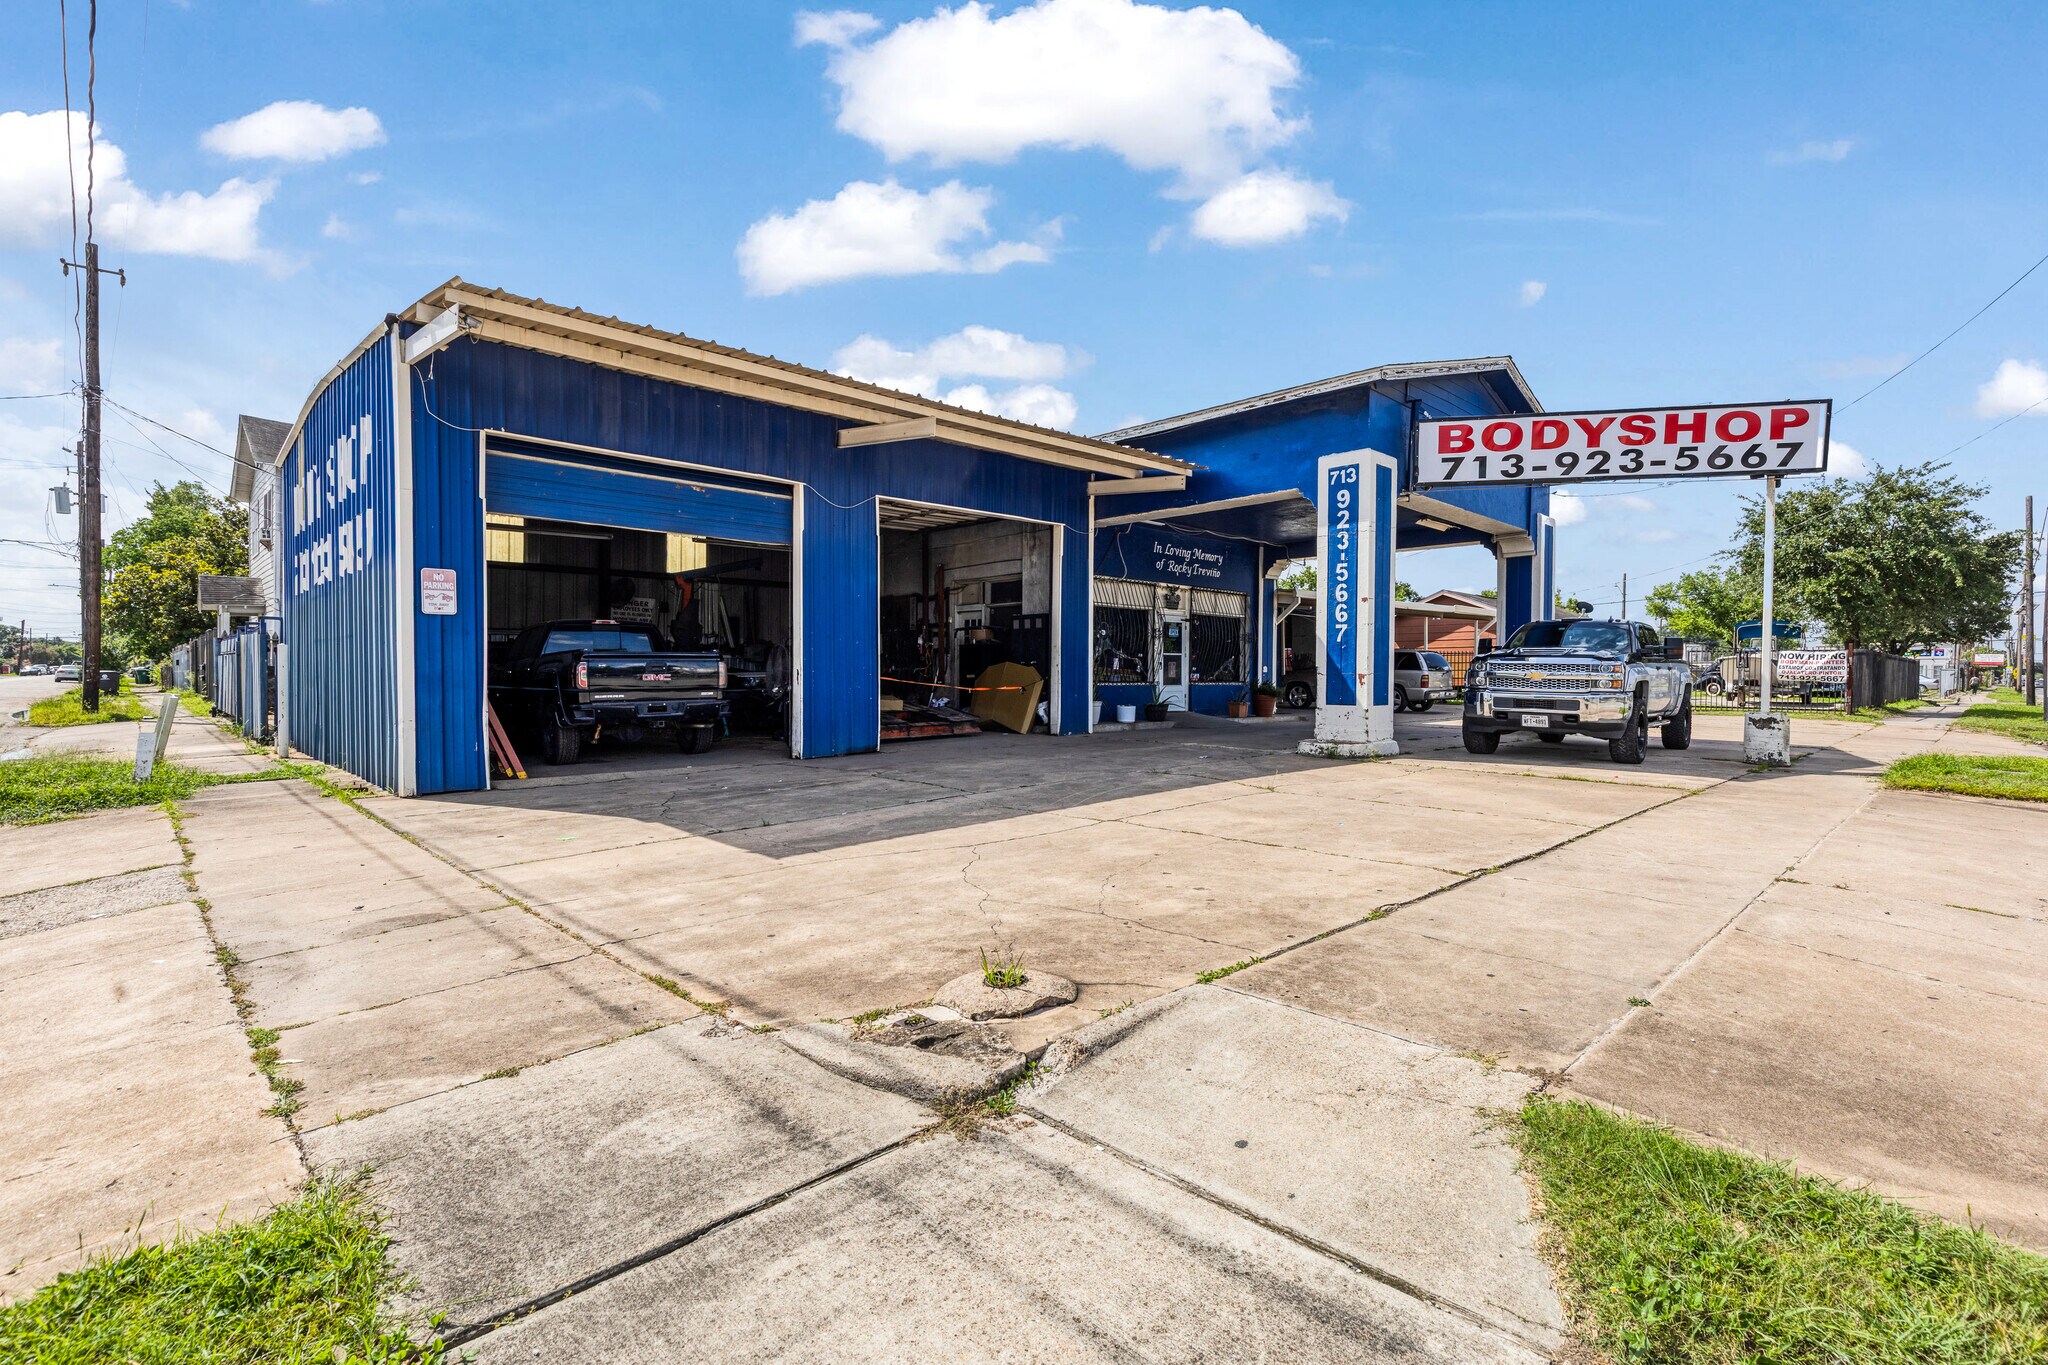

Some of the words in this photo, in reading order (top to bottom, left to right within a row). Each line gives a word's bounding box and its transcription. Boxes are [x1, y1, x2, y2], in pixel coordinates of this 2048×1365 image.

[1438, 408, 1810, 454] BODYSHOP
[1441, 441, 1805, 481] 713-923-5667
[1329, 467, 1357, 486] 713
[1153, 541, 1162, 553] In
[1165, 544, 1192, 561] Loving
[1193, 548, 1223, 566] Memory
[1156, 558, 1166, 570] of
[1168, 560, 1192, 577] Rocky
[423, 581, 454, 590] PARKING
[642, 673, 672, 681] GMC
